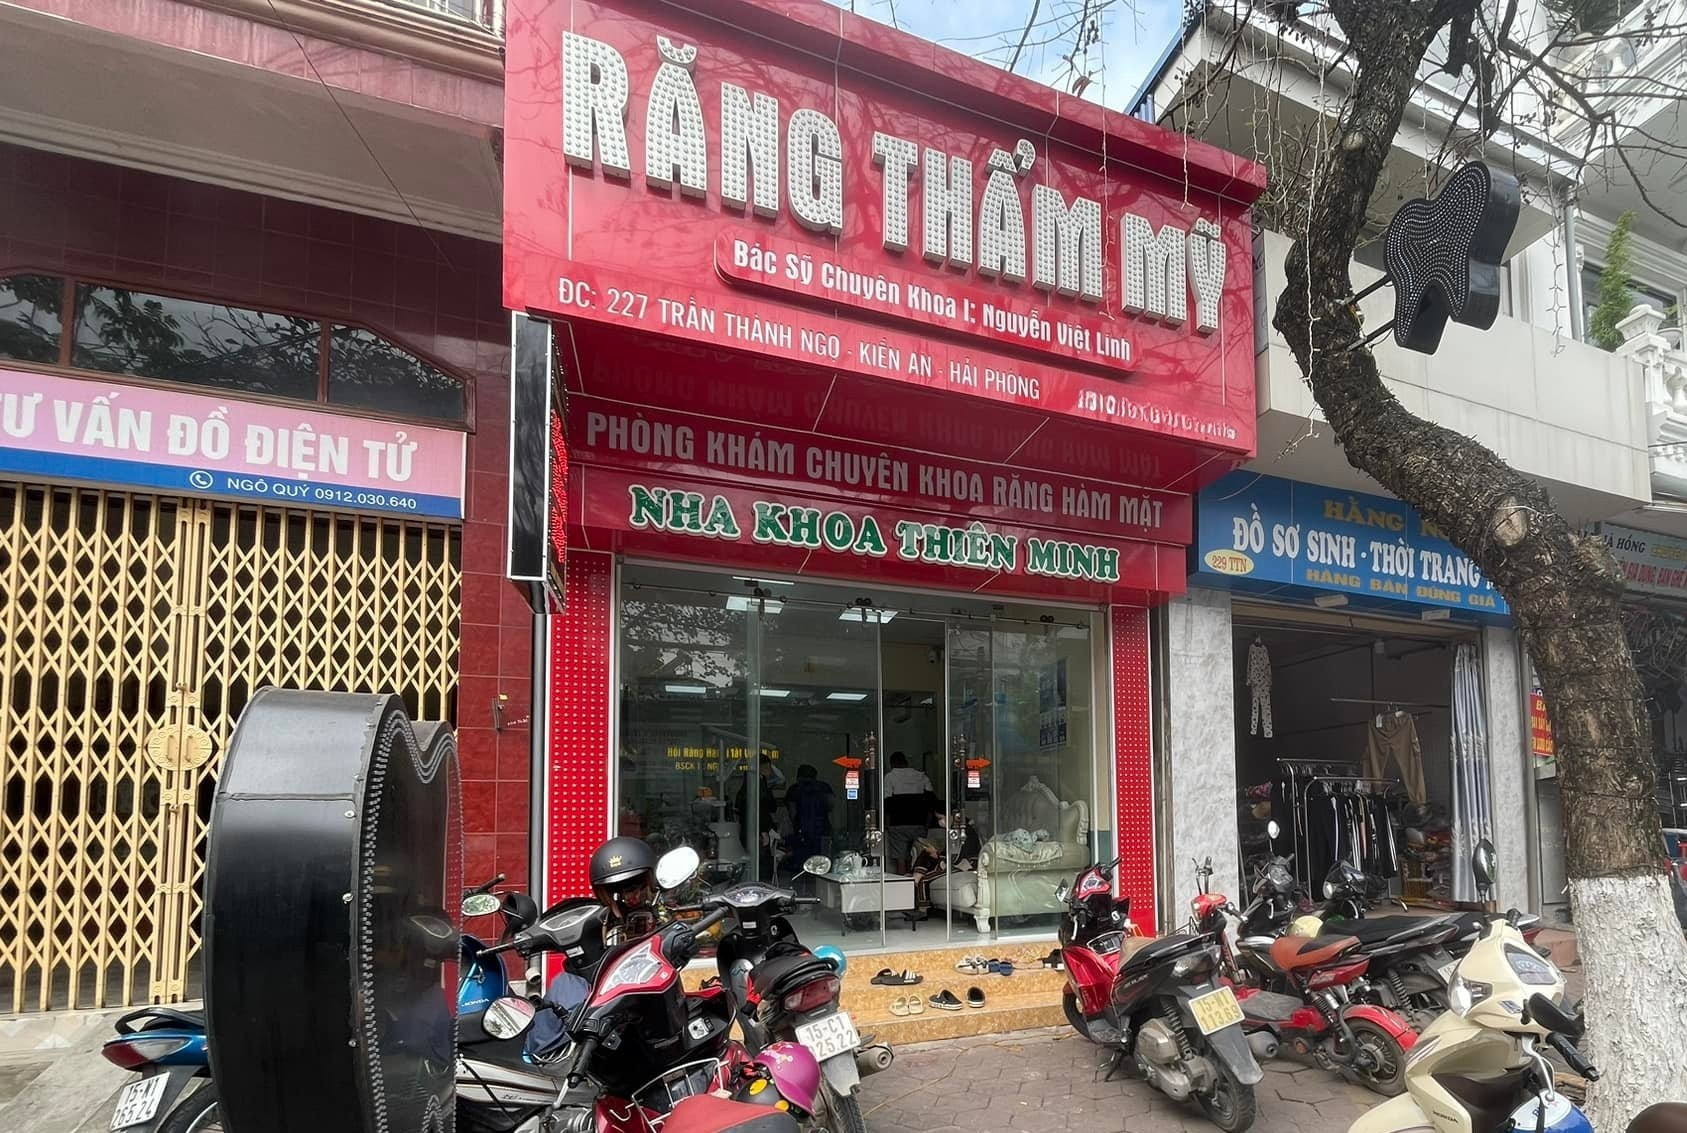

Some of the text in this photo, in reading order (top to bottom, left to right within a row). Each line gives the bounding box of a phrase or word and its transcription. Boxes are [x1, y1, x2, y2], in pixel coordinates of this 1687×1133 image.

[562, 31, 1227, 335] RĂNG THẨM MỸ
[558, 277, 597, 310] ĐC:
[607, 287, 649, 320] 227
[657, 296, 716, 334] TRẦN
[723, 312, 793, 350] THÀNH
[800, 327, 841, 362] NGỌ
[908, 352, 932, 378] AN
[950, 356, 978, 388] HẢI
[984, 367, 1041, 400] PHÒNG
[734, 239, 778, 275] Bác
[785, 252, 814, 286] Sỹ
[821, 261, 901, 305] Chuyên
[907, 284, 956, 319] Khoa
[982, 308, 1051, 342] Nguyễn
[1056, 321, 1091, 354] Việt
[1096, 331, 1131, 361] Linh
[53, 391, 153, 452] VẤN
[166, 406, 230, 461] ĐỒ
[244, 422, 349, 480] ĐIỆN
[362, 431, 418, 482] TỬ
[586, 411, 1164, 533] PHÒNG KHÁM CHUYÊN KHOA RĂNG HÀM MẶT
[227, 477, 417, 510] NGÔ QUÝ 0912.030.640
[628, 484, 1121, 583] NHA KHOA THIÊN MINH
[1211, 555, 1248, 573] 229 TTN
[1232, 502, 1265, 554] ĐỒ
[1272, 523, 1301, 559] SƠ
[1306, 529, 1357, 569] SINH
[1369, 537, 1416, 579] THỜI
[1419, 549, 1481, 589] TRANG
[806, 1015, 846, 1042] 15-C1
[808, 1029, 858, 1059] 25.22
